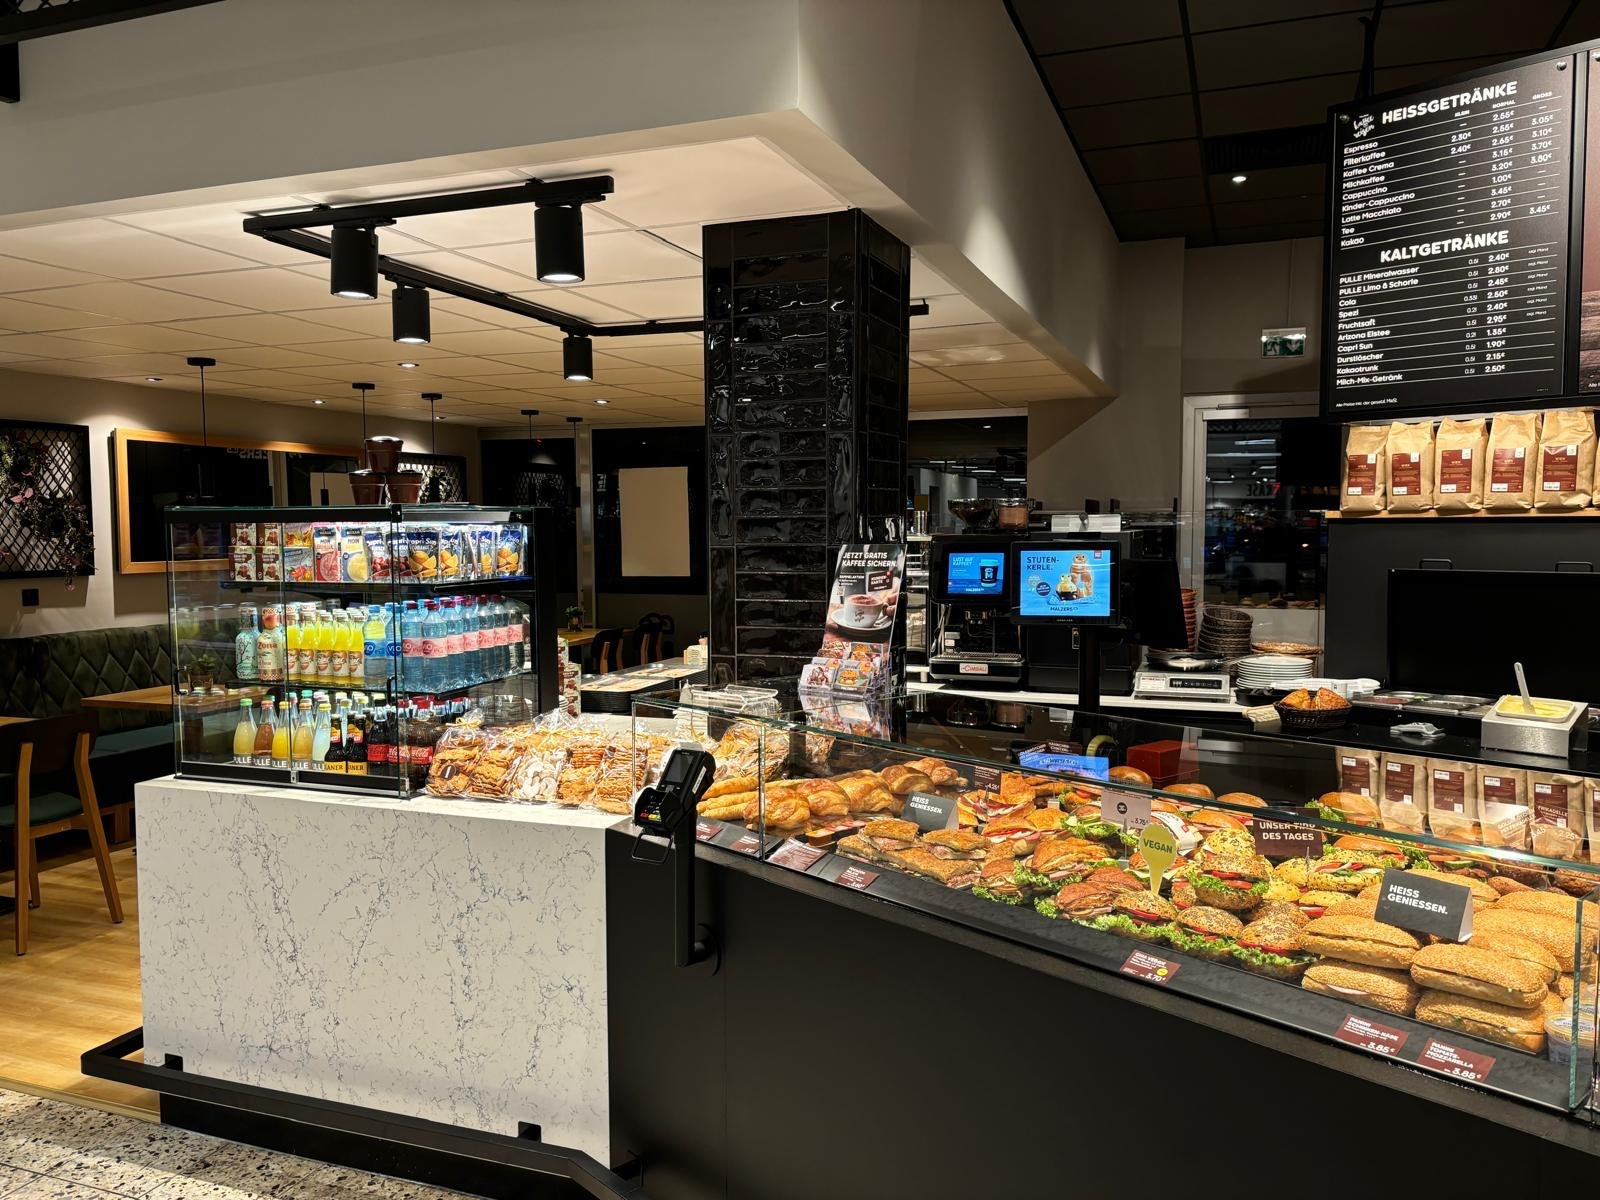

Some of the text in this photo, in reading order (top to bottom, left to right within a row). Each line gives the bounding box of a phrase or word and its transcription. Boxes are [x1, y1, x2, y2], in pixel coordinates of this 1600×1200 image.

[1382, 81, 1518, 124] HEISSGETRÄNKE
[1344, 142, 1378, 154] Espresso
[1343, 167, 1367, 178] Kaffee
[1368, 162, 1394, 172] Crema
[1450, 144, 1471, 154] 2.40€
[1344, 152, 1386, 166] Filterkaffee
[1343, 176, 1385, 190] Milchkaffee
[1342, 173, 1512, 212] Kinder-Cappuccino 1.00€
[1342, 186, 1388, 200] Cappuccino
[1491, 199, 1511, 208] 2.70€
[1342, 215, 1361, 224] Latte
[1362, 207, 1402, 220] Macchiato
[1341, 237, 1364, 247] Kakao
[1490, 211, 1511, 221] 2.90€
[1380, 230, 1509, 263] KALTGETRÄNKE
[1340, 274, 1362, 284] PULLE
[1363, 267, 1420, 280] Mineralwasser
[1488, 253, 1510, 262] 2.40€
[1340, 286, 1362, 296] PULLE
[1363, 284, 1381, 292] Limo
[1389, 278, 1419, 288] Schorle
[1338, 318, 1376, 330] Fruchtsaft
[1487, 302, 1508, 311] 2.40€
[1339, 309, 1359, 318] Spezi
[1338, 331, 1366, 341] Arizona
[1367, 329, 1390, 337] Eistee
[1486, 315, 1507, 324] 2.95€
[1337, 353, 1384, 364] Durstlöscher
[1486, 340, 1506, 348] 1.90€
[1338, 344, 1358, 353] Capri
[1337, 365, 1379, 375] Kakaotrunk
[1486, 352, 1506, 361] 2.15€
[1337, 374, 1403, 386] Milch-Mix-Getränk
[912, 796, 929, 805] HEISS
[1143, 838, 1172, 853] VEGAN
[1389, 884, 1420, 898] HEISS
[1387, 893, 1448, 915] GENIESSEN.
[1426, 1050, 1474, 1068] MOZZARELLA
